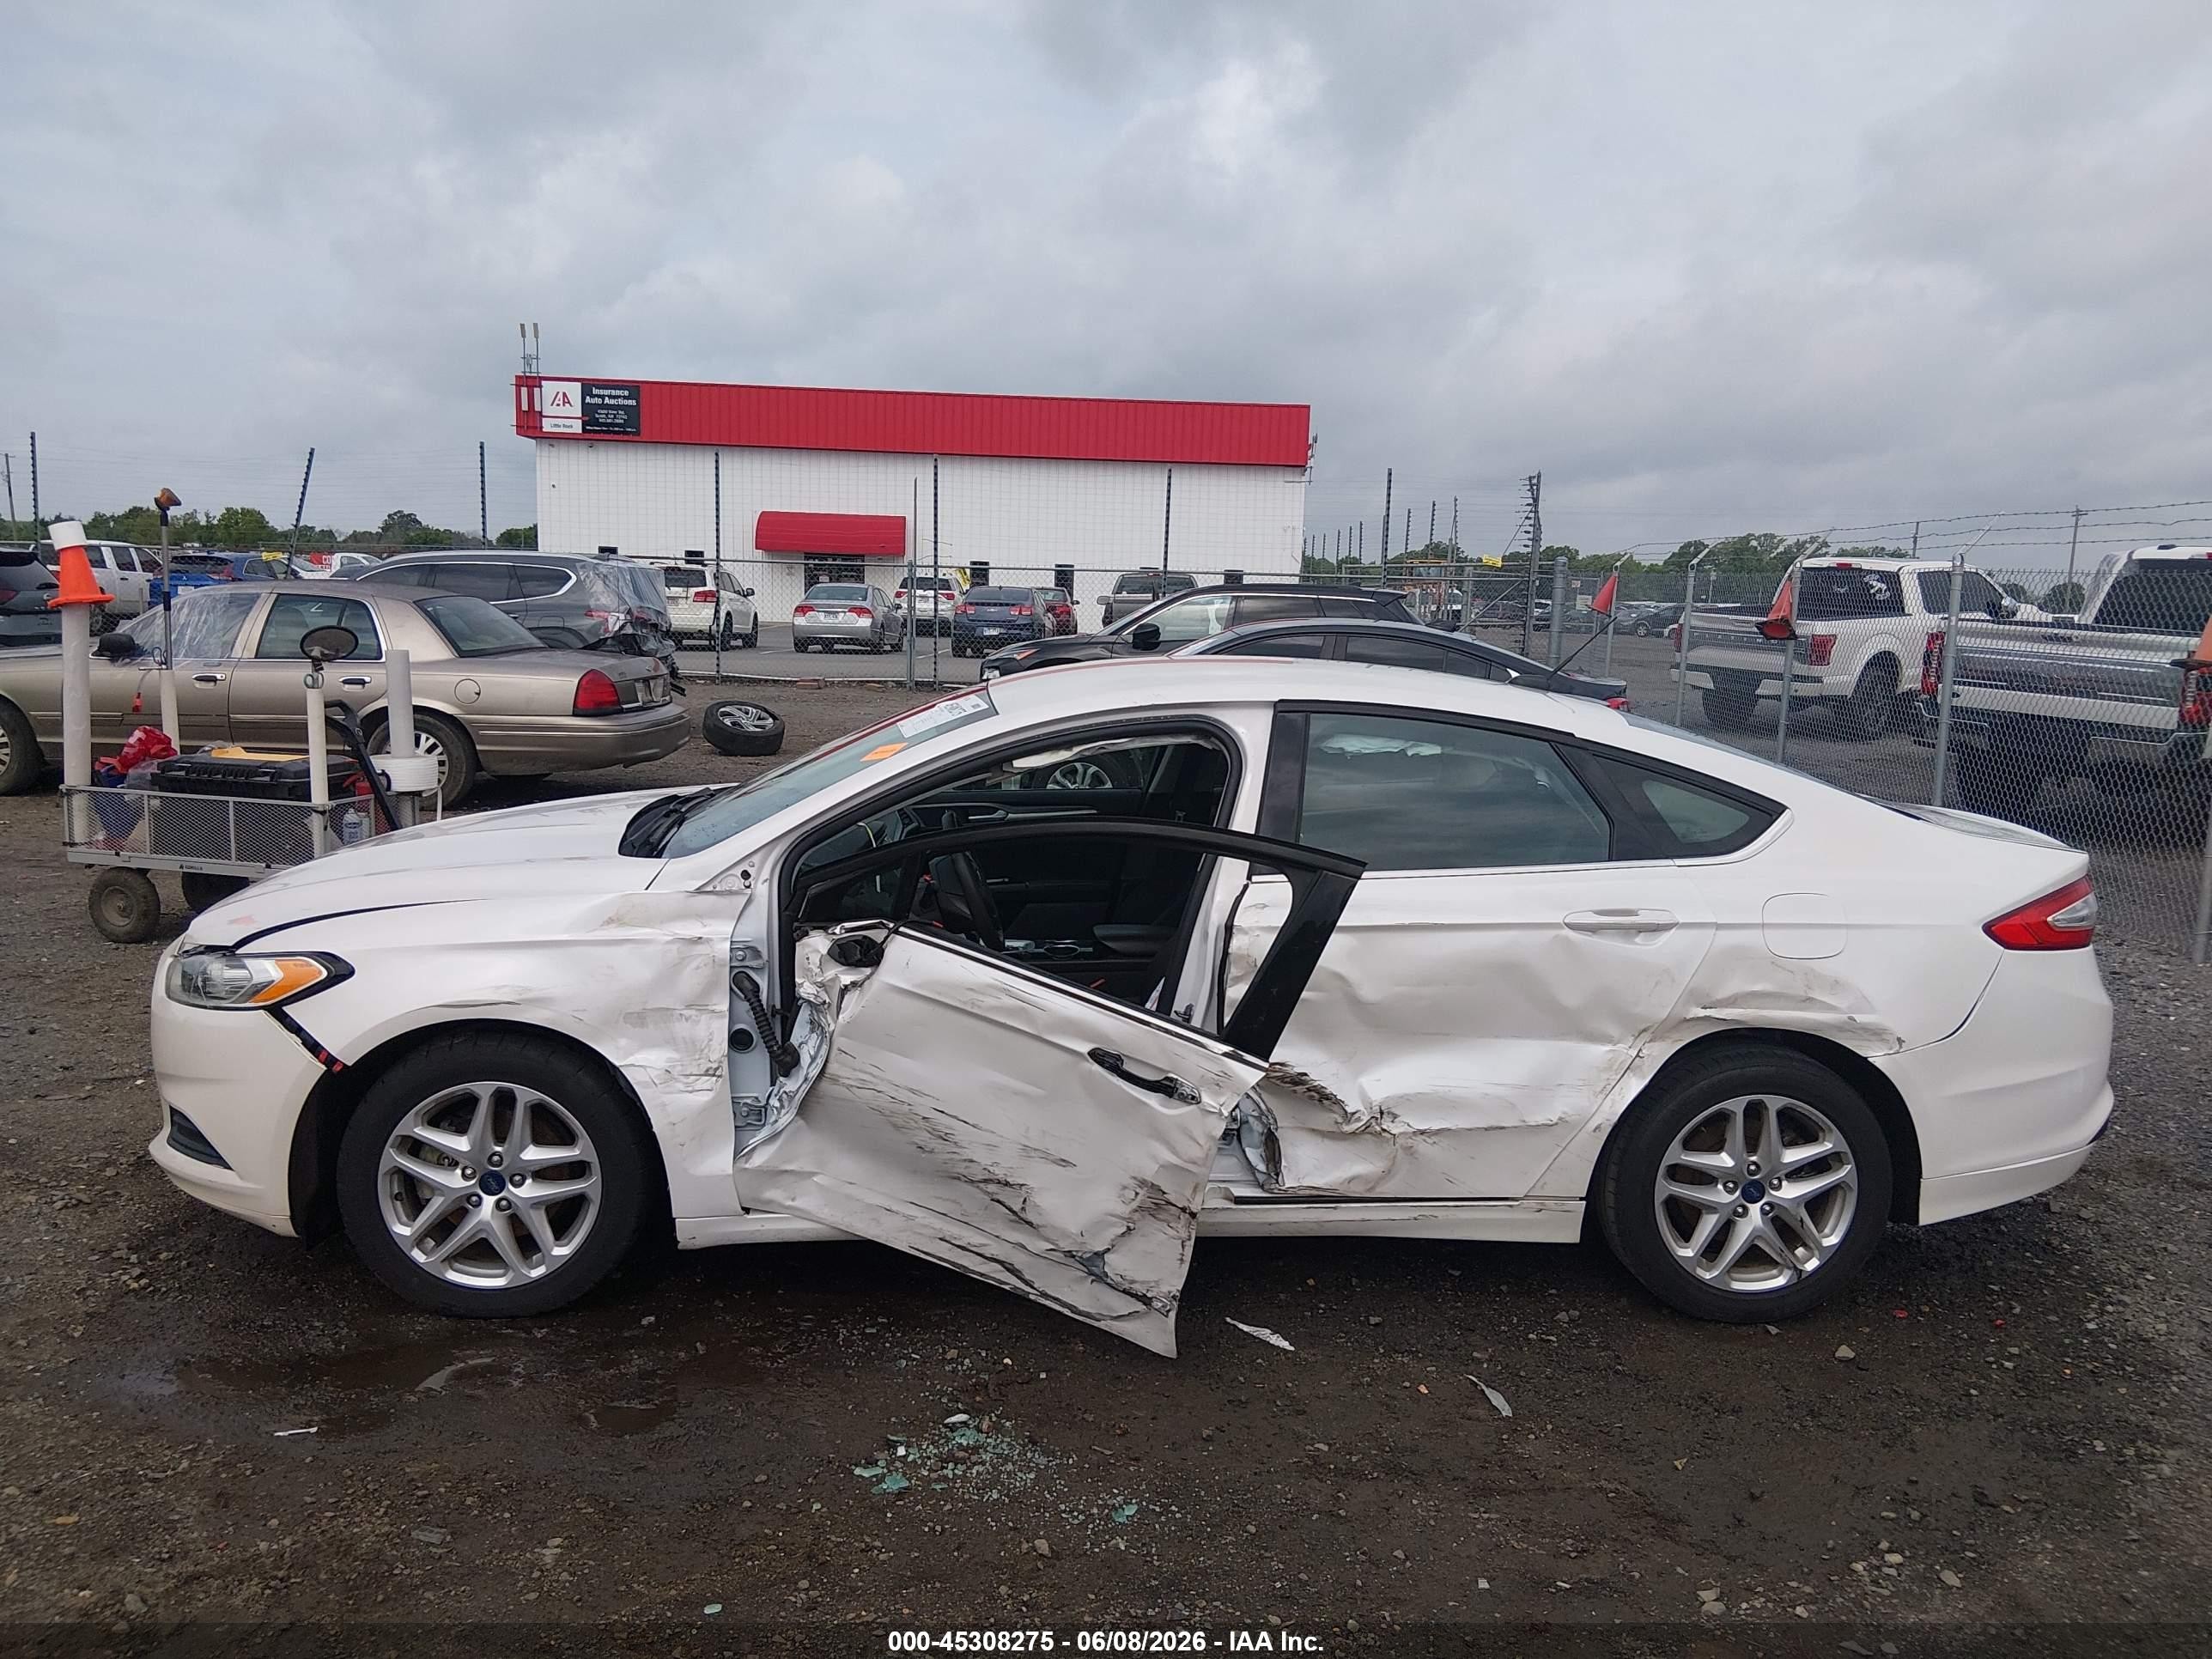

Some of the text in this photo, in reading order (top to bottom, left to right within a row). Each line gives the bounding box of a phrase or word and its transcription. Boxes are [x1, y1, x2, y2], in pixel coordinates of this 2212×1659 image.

[592, 386, 629, 397] Insurance
[585, 396, 637, 406] Auto Auctions
